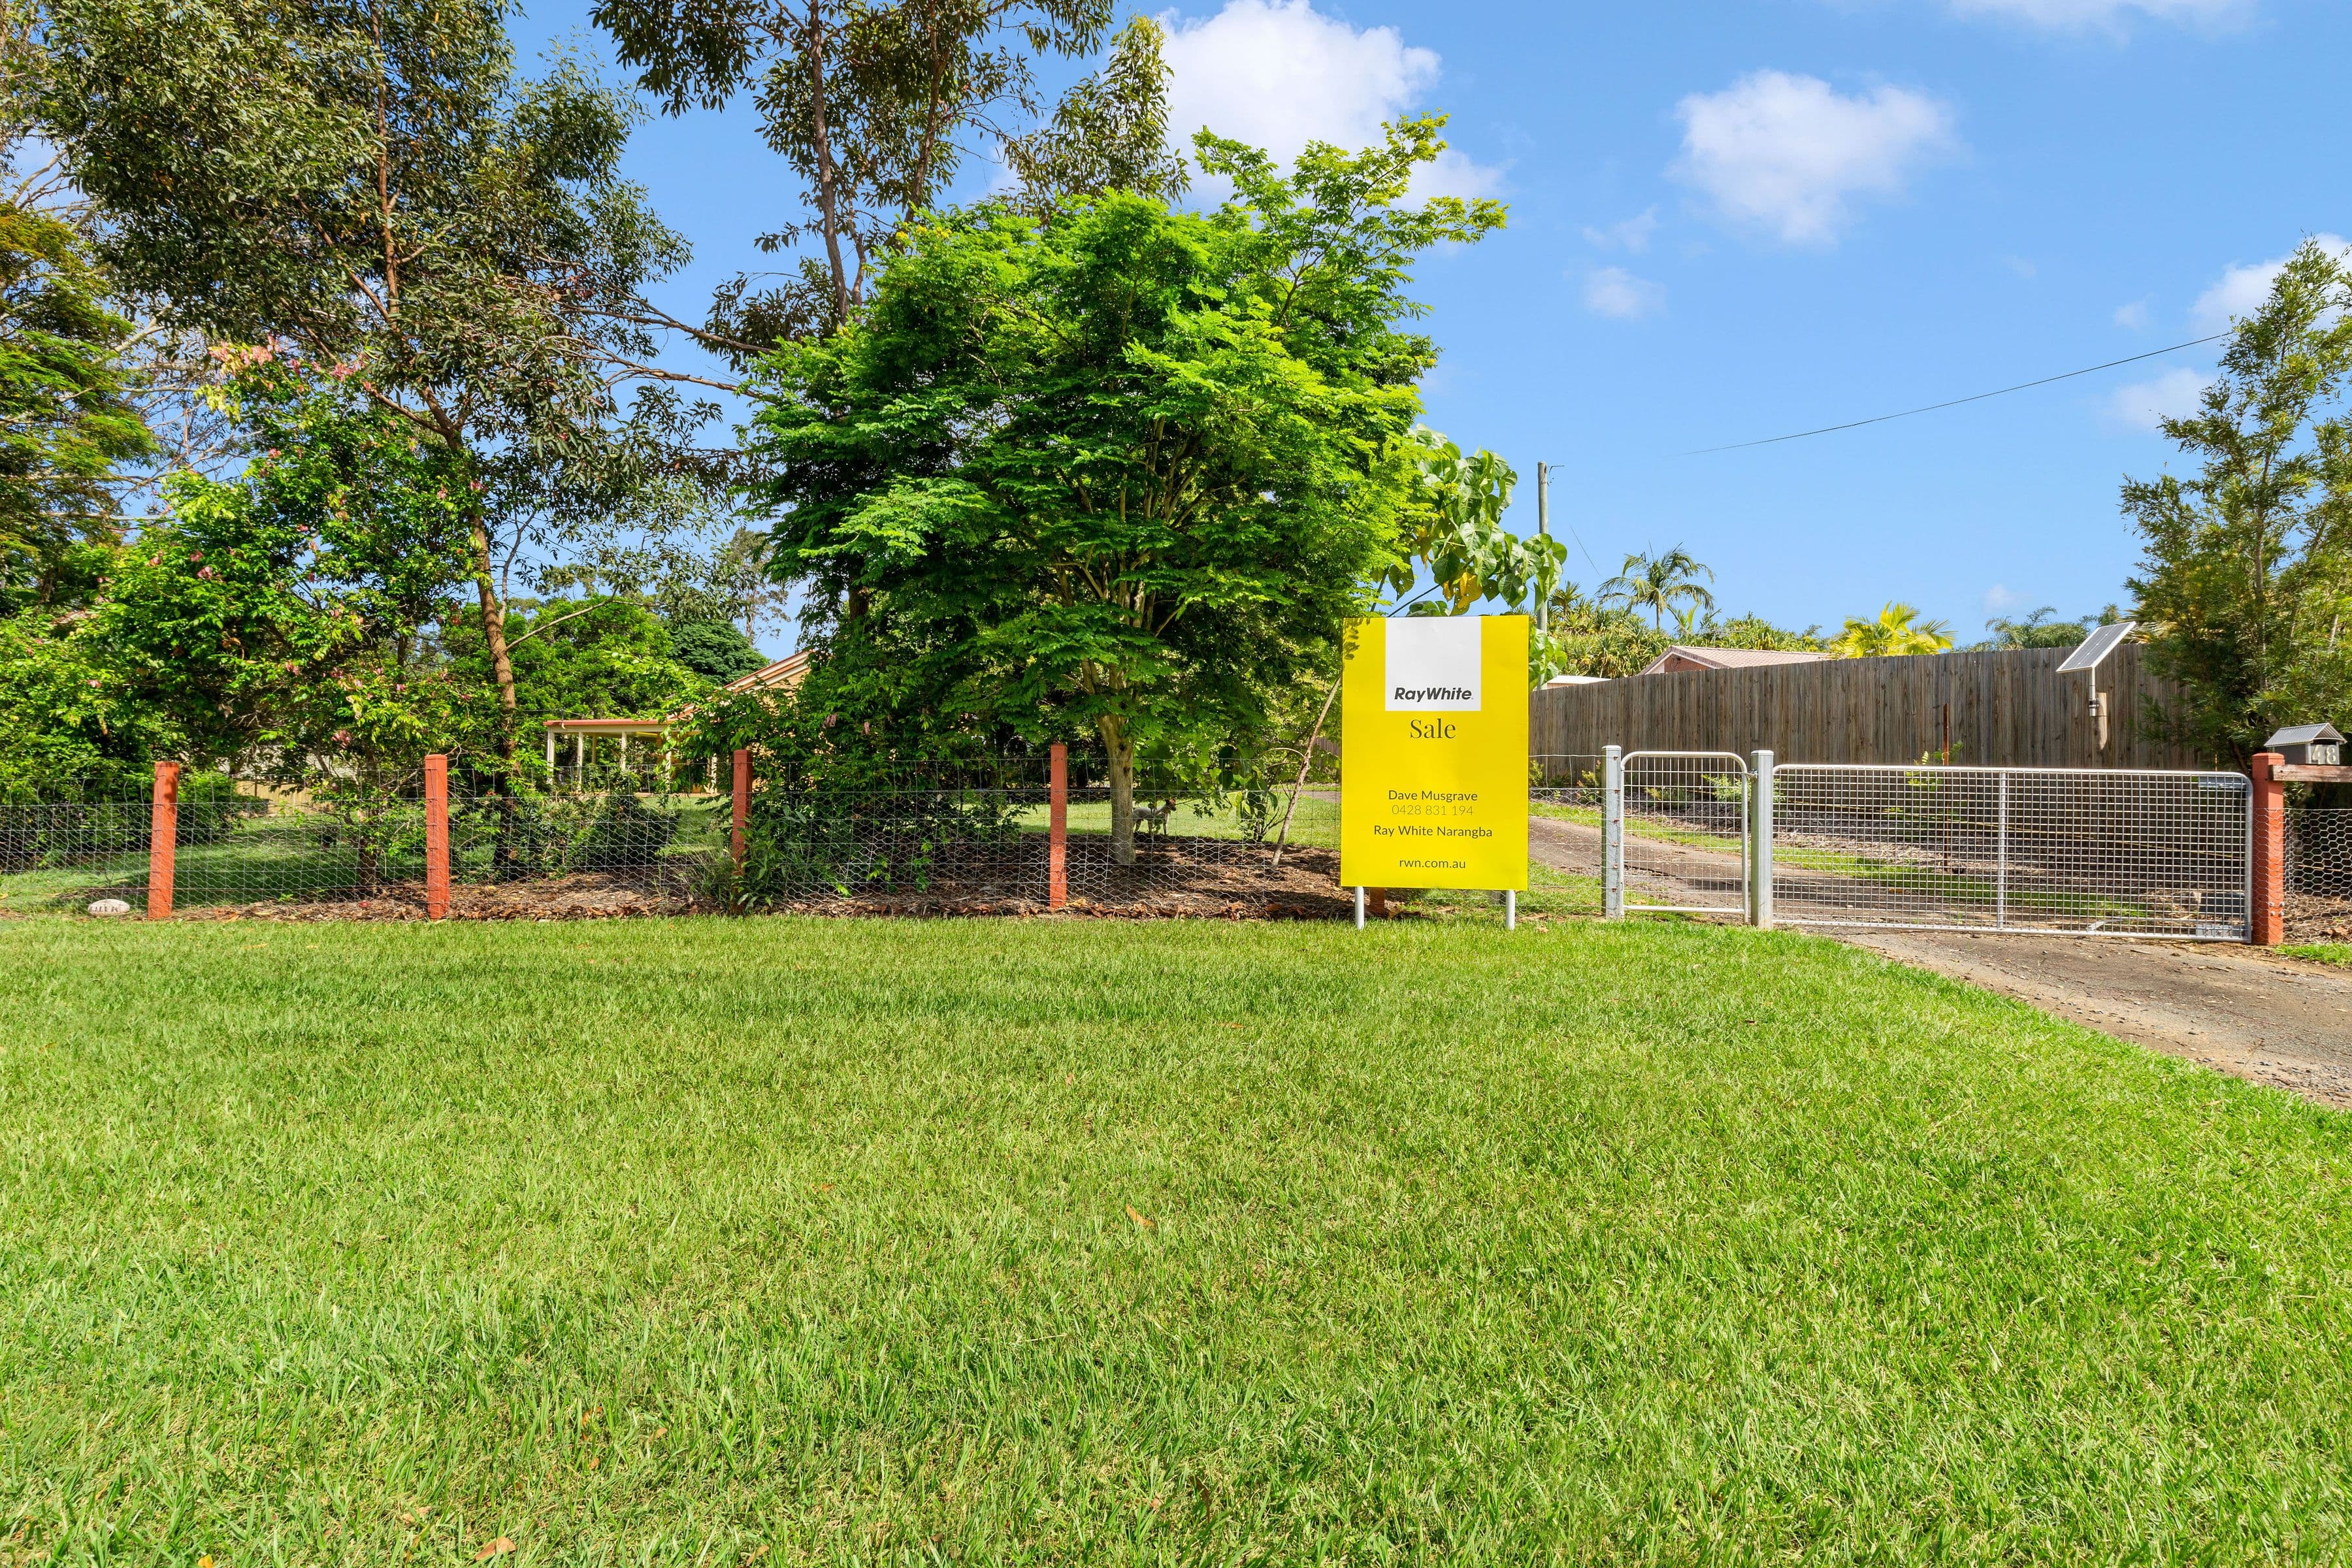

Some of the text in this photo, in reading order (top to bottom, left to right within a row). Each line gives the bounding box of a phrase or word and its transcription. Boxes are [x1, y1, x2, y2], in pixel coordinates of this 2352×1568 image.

[1410, 718, 1456, 739] Sale
[2311, 744, 2337, 764] 48
[1388, 790, 1478, 803] Dave Musgrave
[1392, 804, 1473, 816] 0428 831 194
[1374, 825, 1493, 839] Ray White Narangba
[1399, 859, 1466, 869] rwn.com.au
